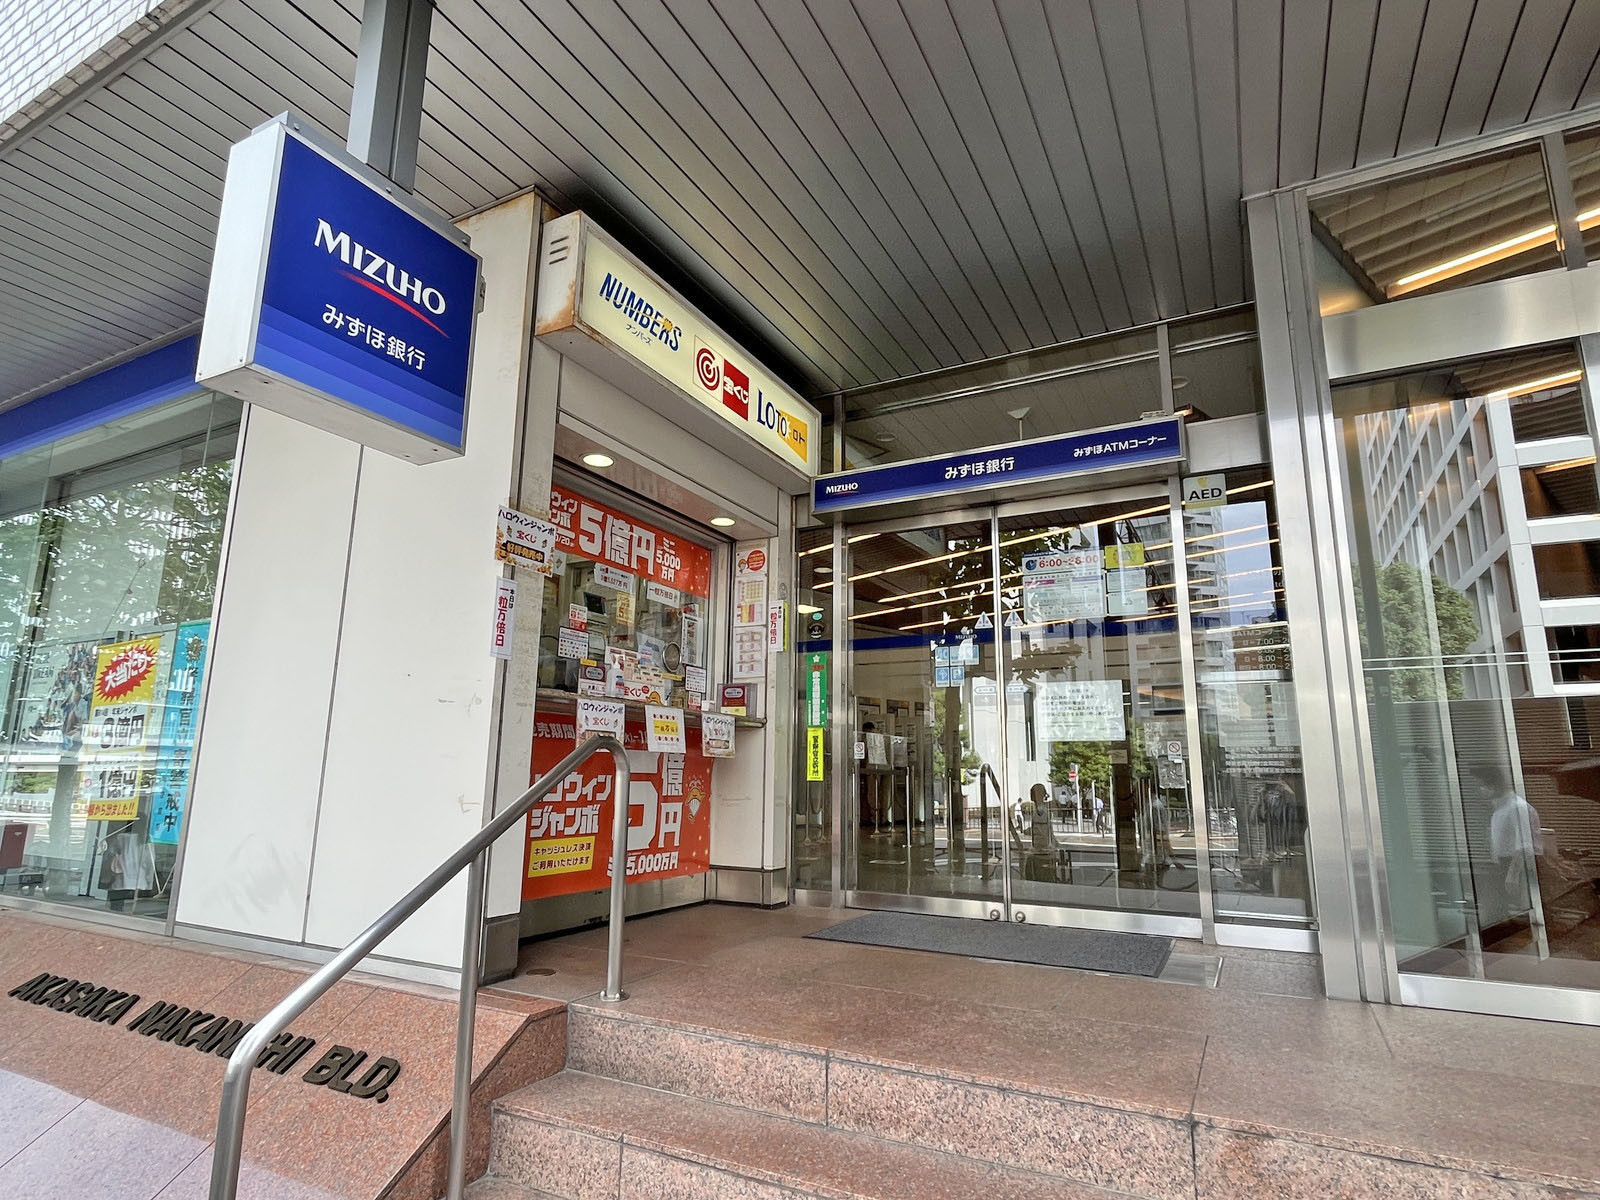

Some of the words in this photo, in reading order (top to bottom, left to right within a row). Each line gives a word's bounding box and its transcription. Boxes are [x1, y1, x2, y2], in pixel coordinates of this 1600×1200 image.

[314, 217, 447, 315] MIZUHO
[599, 272, 682, 352] NUMBERS
[322, 303, 427, 371] みずほ銀行
[625, 321, 654, 347] ナンバーズ
[723, 374, 749, 405] 宝くじ
[756, 388, 788, 437] LOTO
[792, 427, 806, 445] ロト
[1073, 434, 1168, 458] みずほATMコーナー
[944, 456, 1016, 481] みずほ銀行
[825, 482, 859, 495] MIZUHO
[1189, 486, 1223, 501] AED
[498, 509, 555, 536] ハロウィンジャンボ
[516, 530, 537, 544] 宝くじ
[578, 501, 657, 576] 5億円
[656, 549, 681, 571] 5,000
[661, 565, 674, 582] 万円
[495, 587, 510, 647] 一粒万倍日
[533, 721, 575, 740] 売期間
[592, 716, 610, 726] 宝くじ
[529, 804, 600, 838] ジャンボ
[534, 841, 592, 857] キャッシュレス決済
[531, 855, 590, 871] ご利用いただけます
[7, 972, 140, 1026] AKASAKA
[126, 1000, 316, 1076] NAKANHI
[302, 1044, 401, 1104] BLD.
